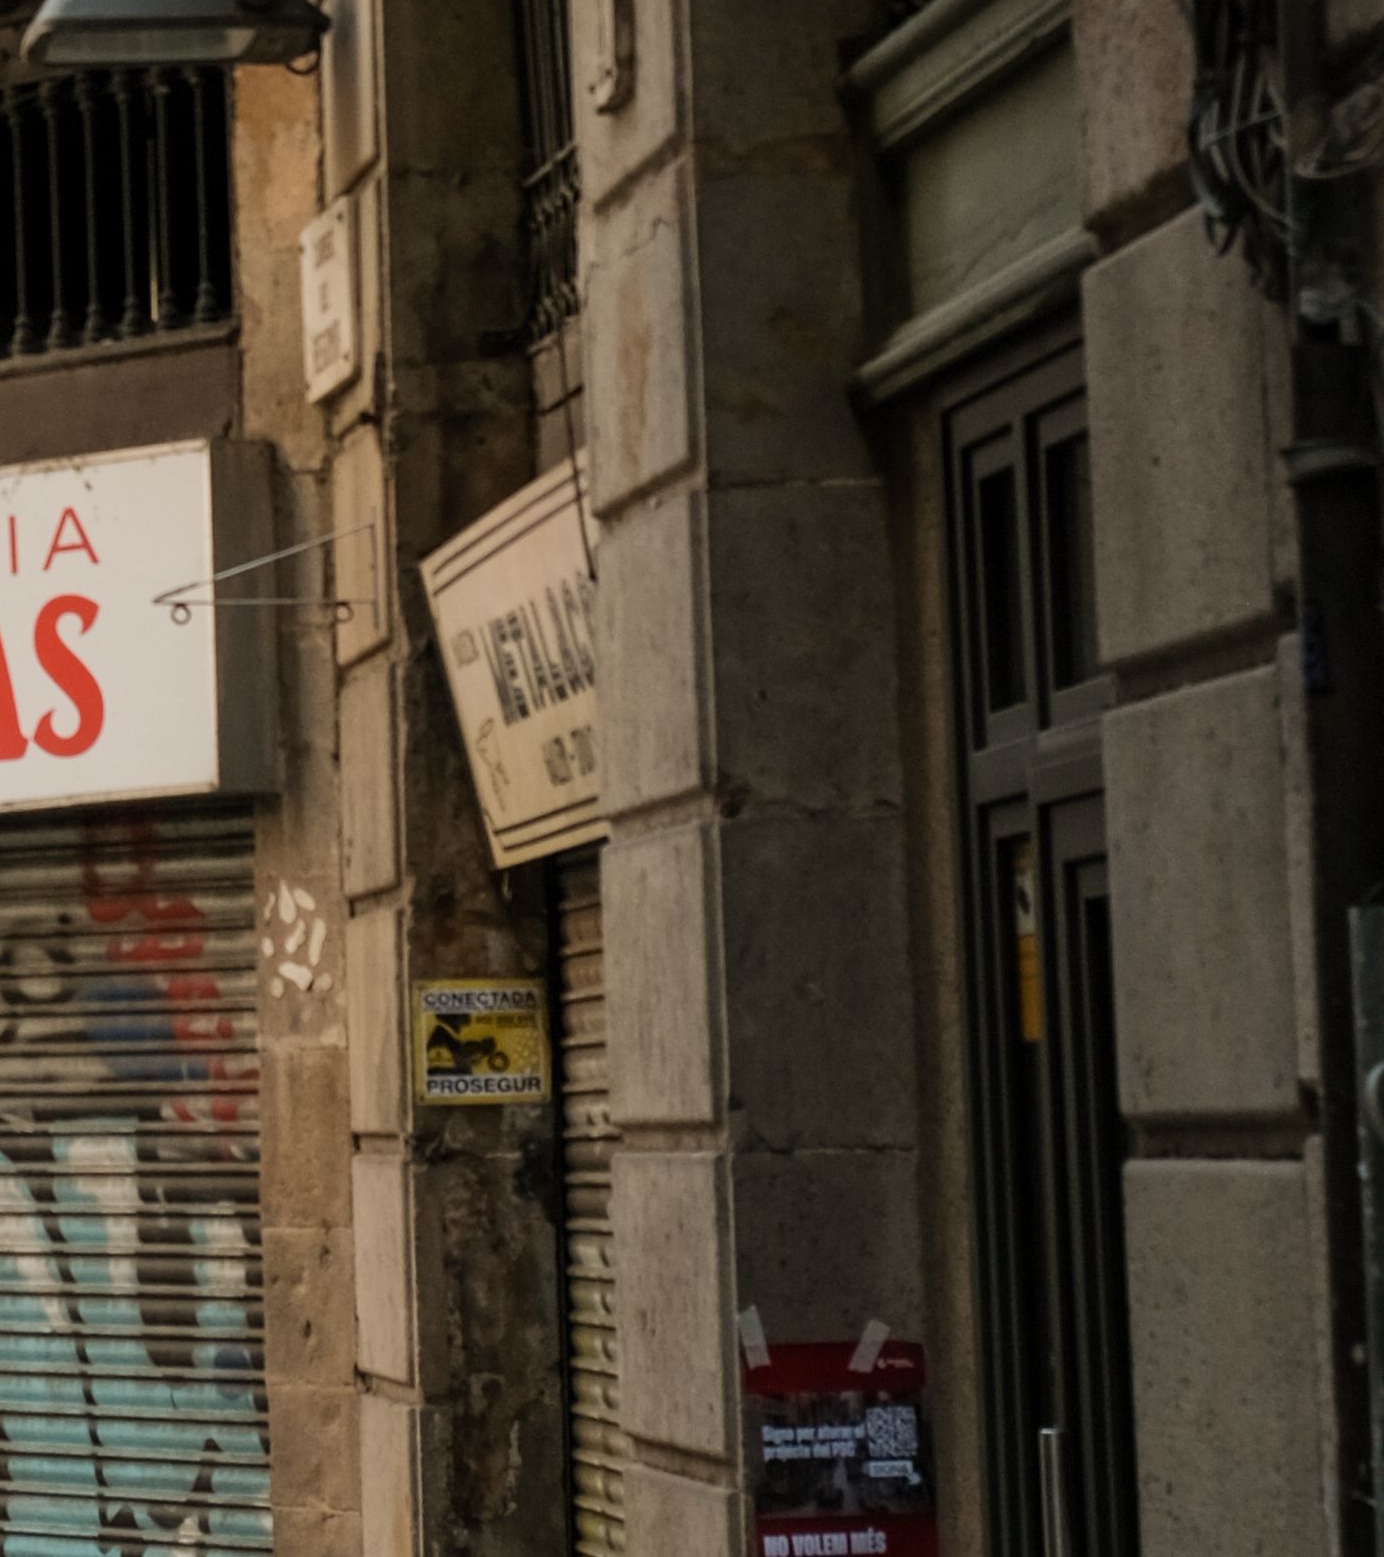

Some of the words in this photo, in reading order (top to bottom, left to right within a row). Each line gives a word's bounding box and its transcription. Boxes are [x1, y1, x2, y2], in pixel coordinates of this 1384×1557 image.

[424, 991, 537, 1008] CONECTADA
[427, 1075, 542, 1094] PROSEGUR
[764, 1534, 790, 1557] NO
[792, 1532, 848, 1557] VOLEM
[850, 1527, 887, 1554] MÉS
